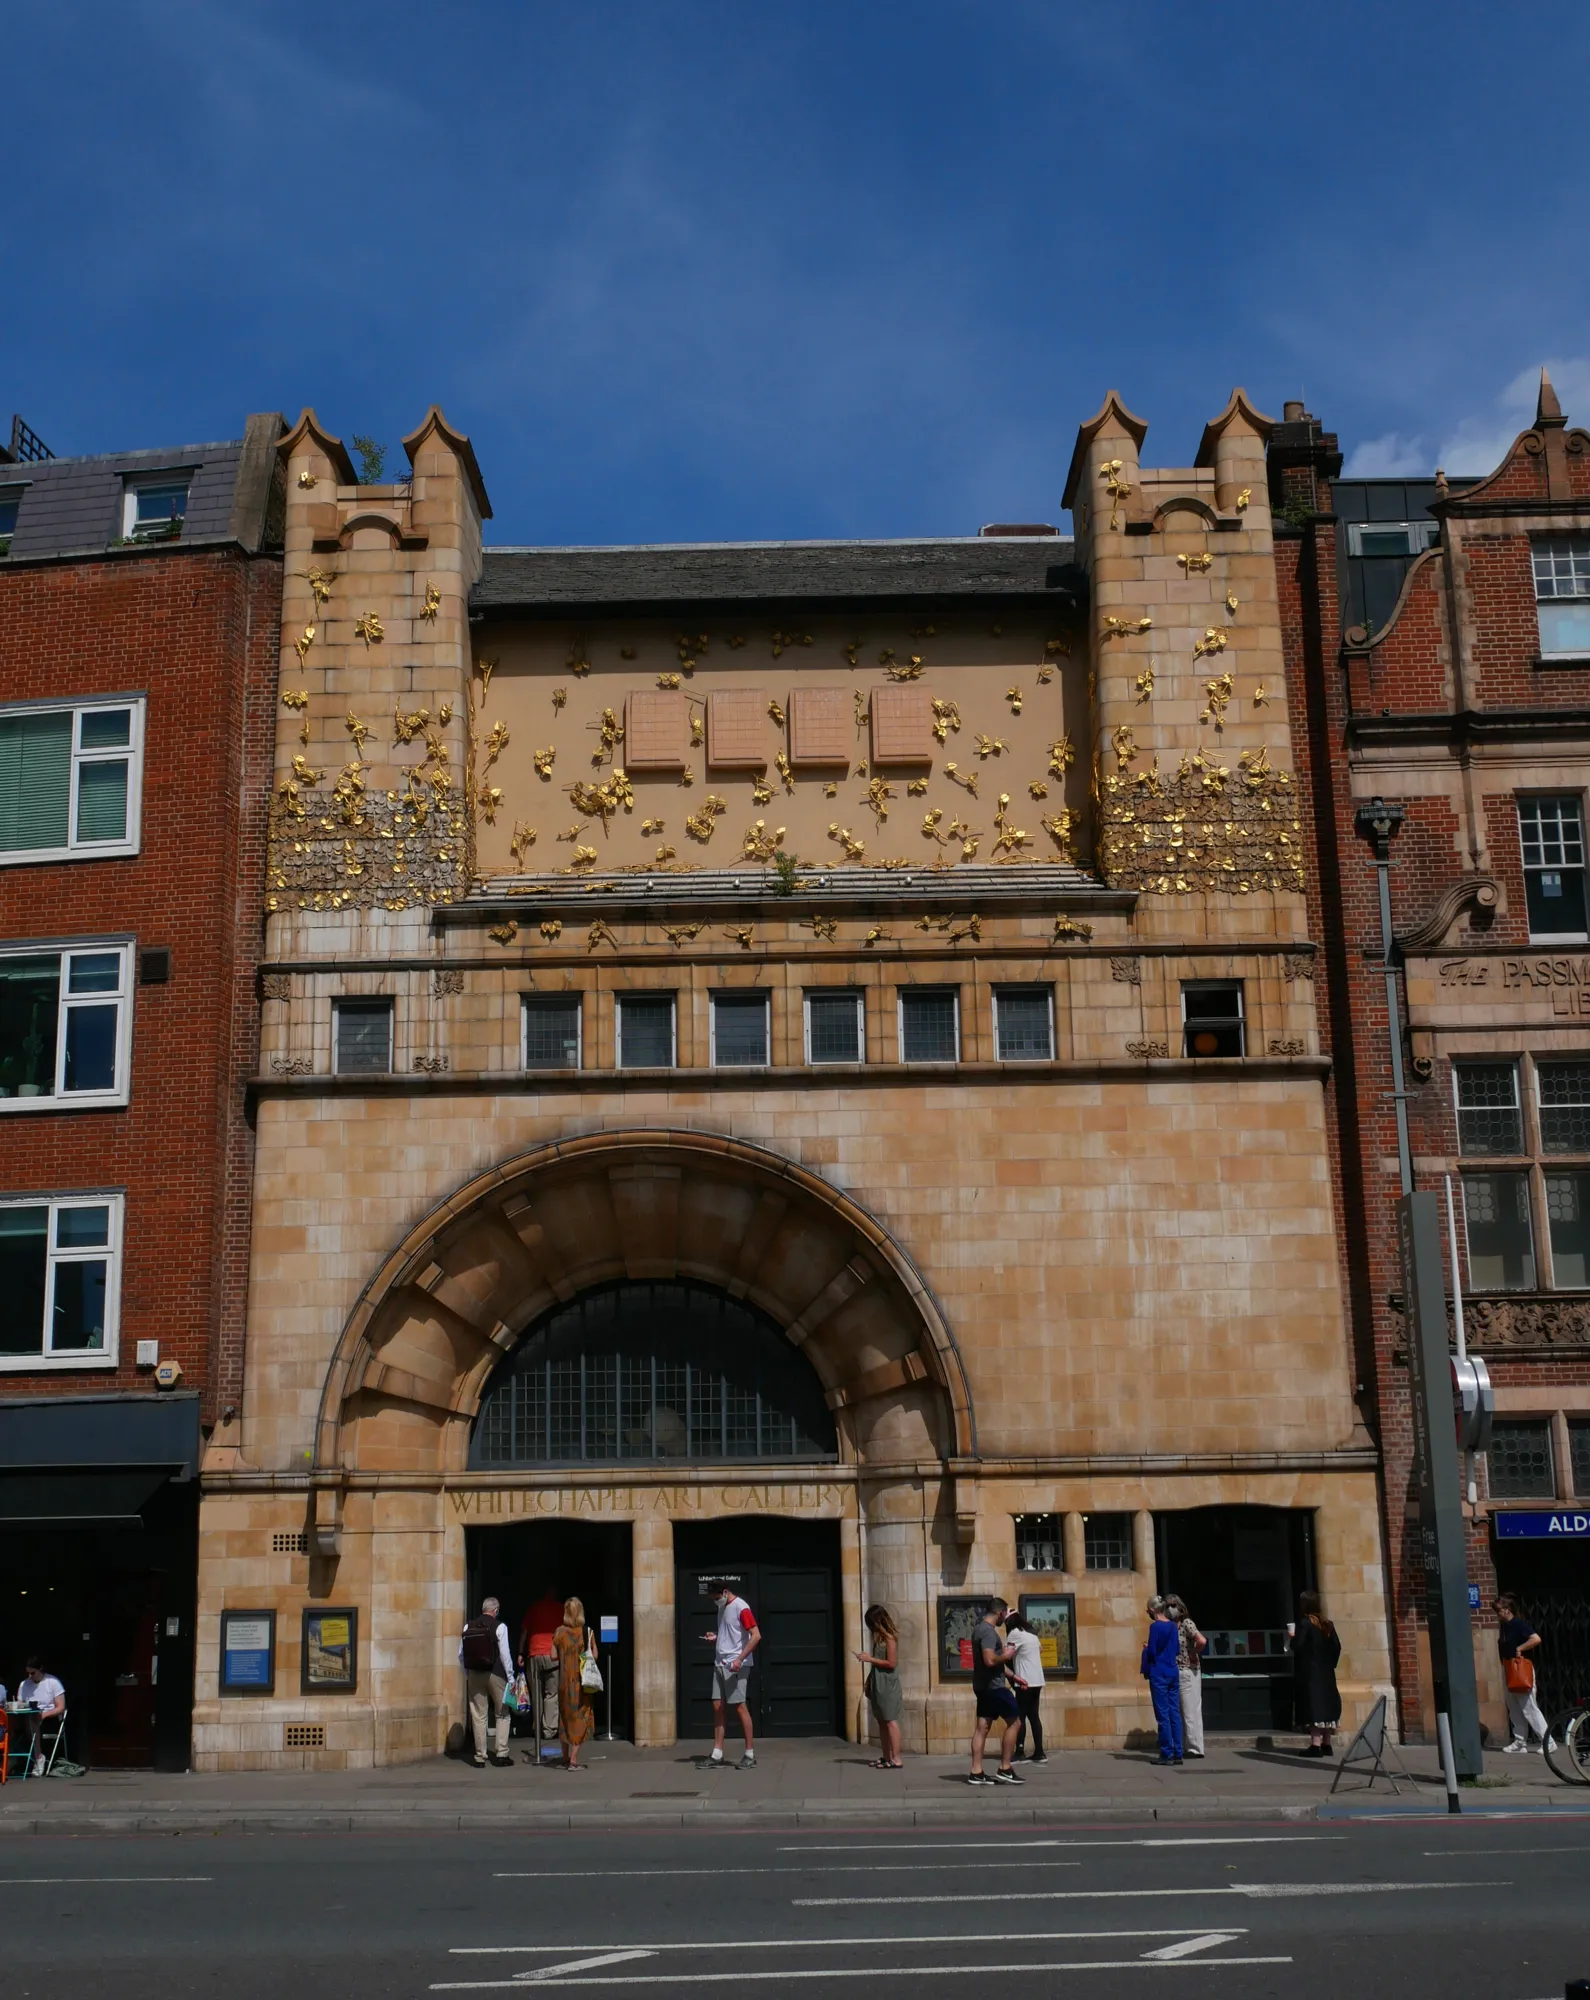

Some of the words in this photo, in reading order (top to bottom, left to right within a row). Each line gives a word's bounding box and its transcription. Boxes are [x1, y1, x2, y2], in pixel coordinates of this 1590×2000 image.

[1439, 958, 1488, 986] THE
[1402, 1210, 1420, 1381] Whitechapel
[1416, 1391, 1428, 1487] Gallery
[449, 1486, 644, 1514] WHITECHAPEL
[653, 1485, 703, 1510] ART
[720, 1484, 851, 1510] GALLERY
[1422, 1527, 1435, 1544] Free
[1548, 1515, 1590, 1532] ALD
[1424, 1552, 1439, 1574] Entry
